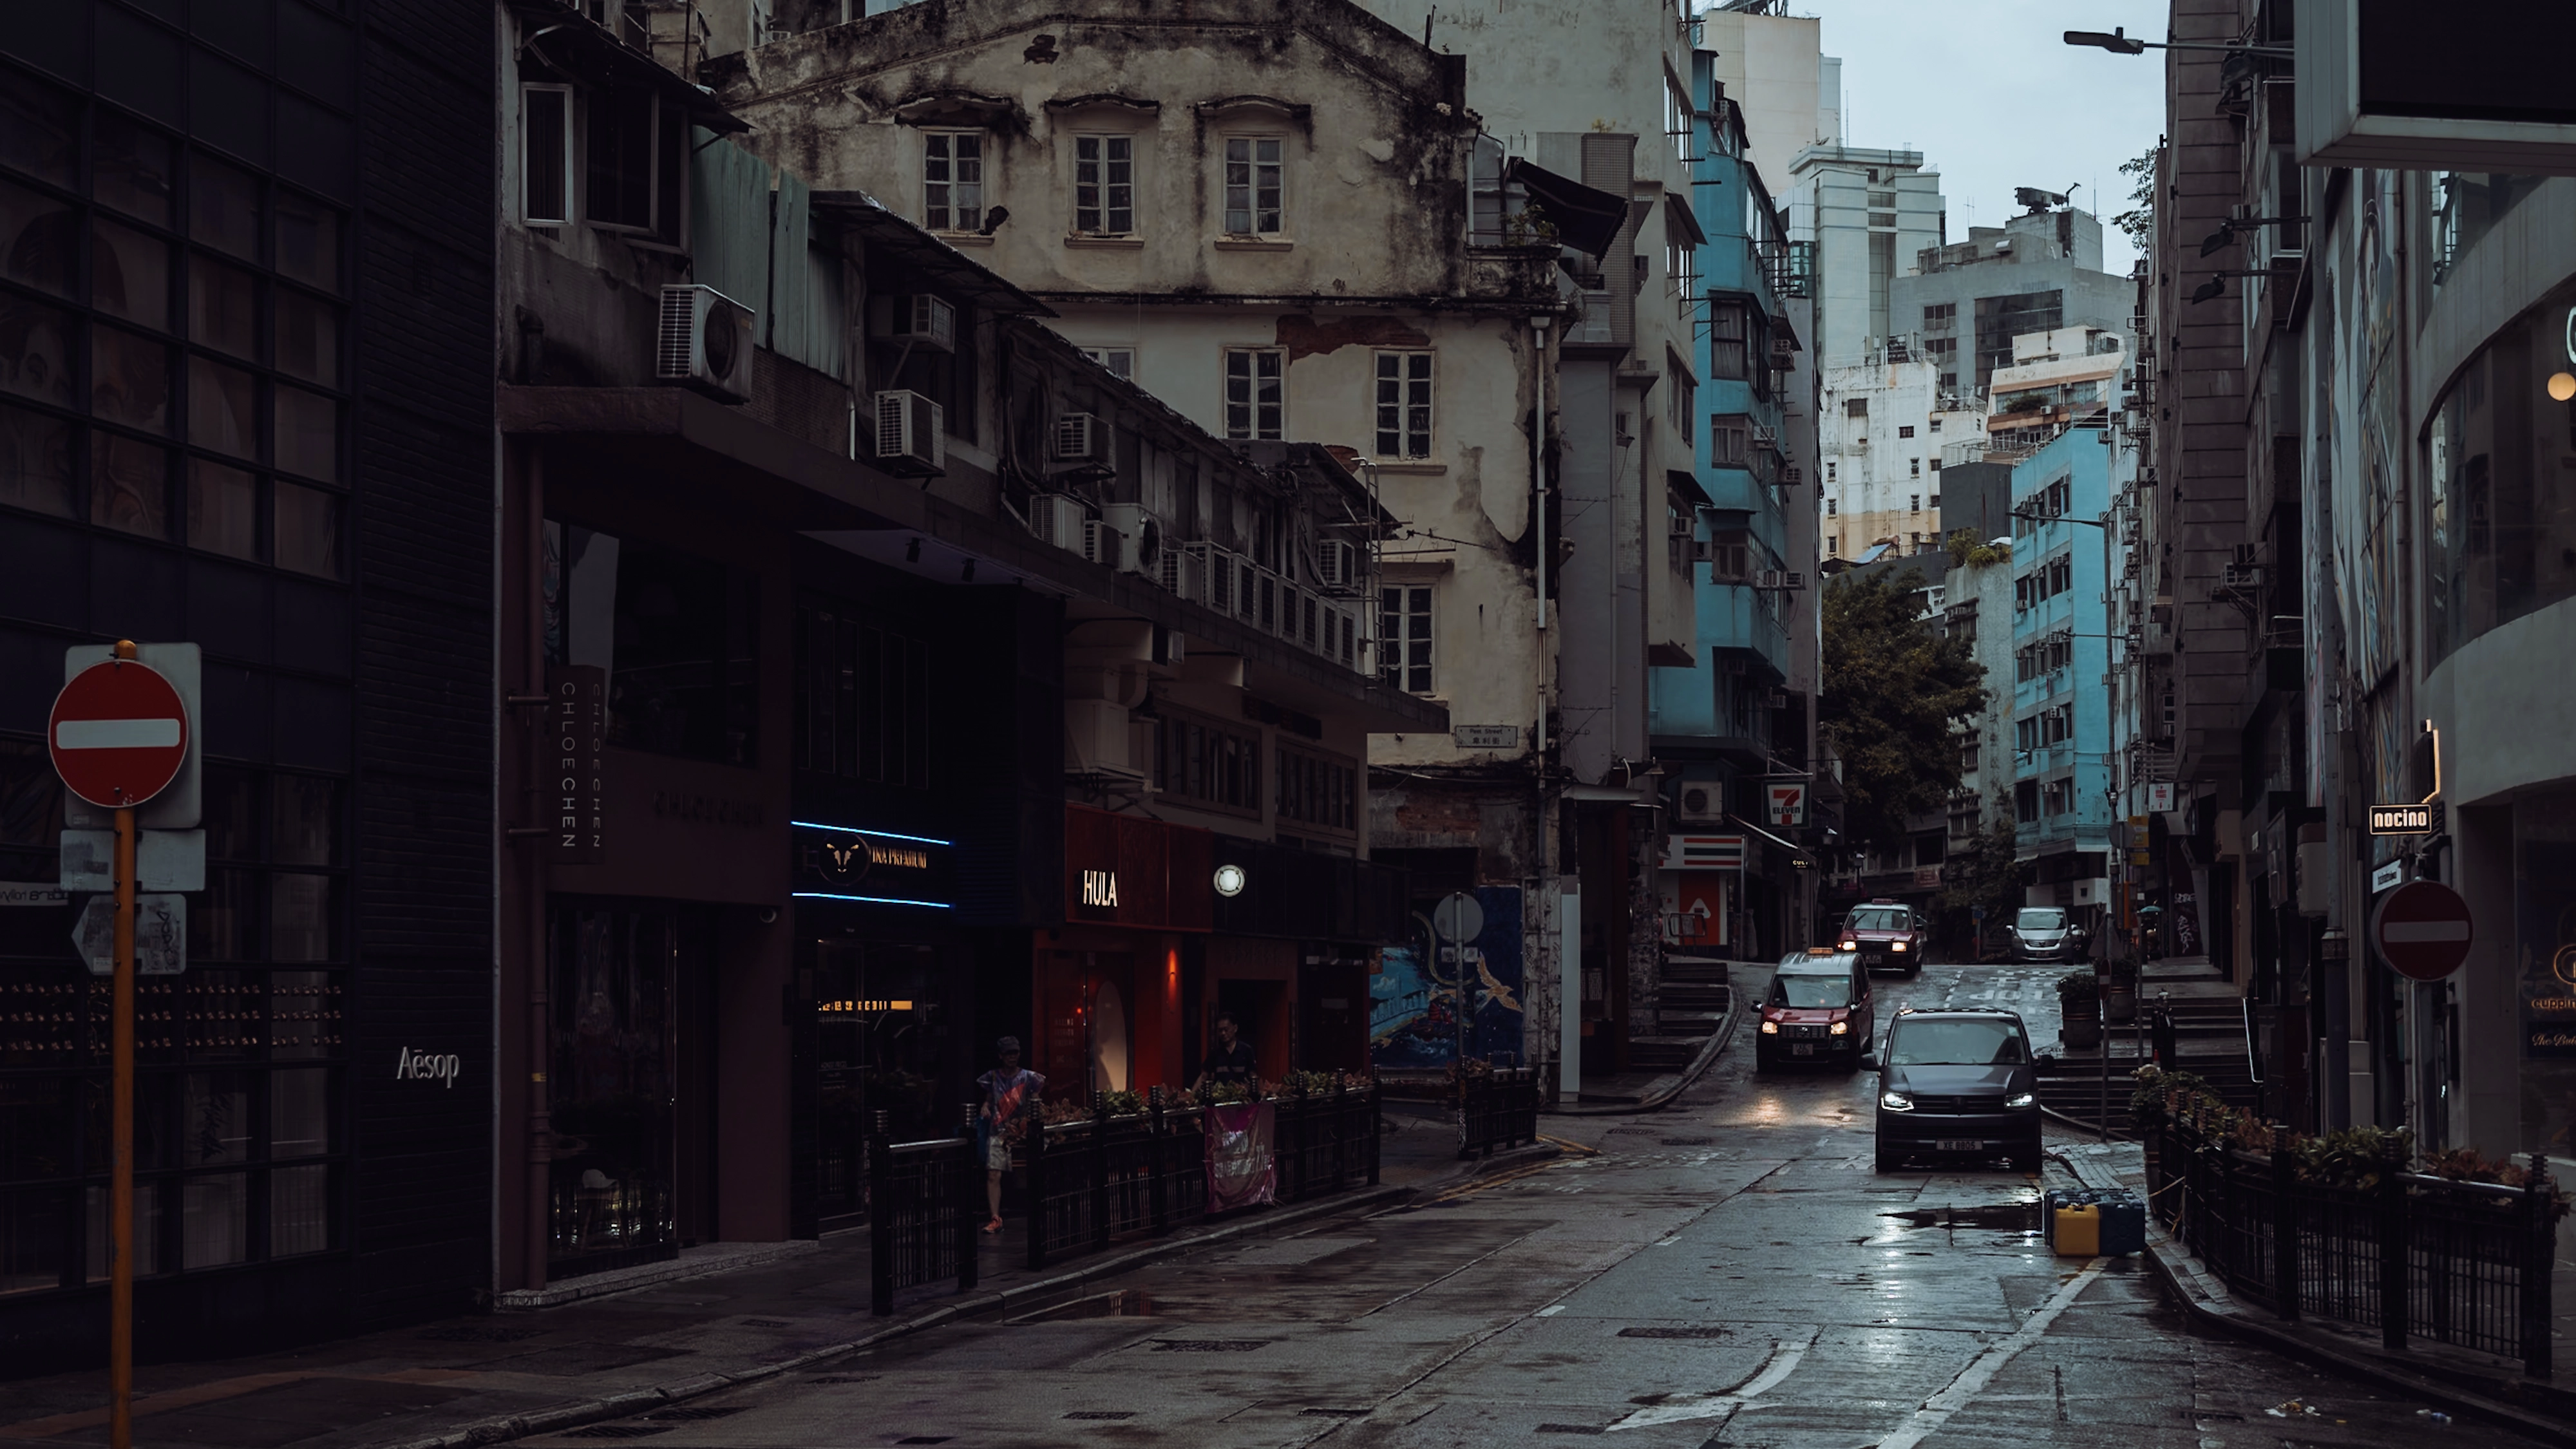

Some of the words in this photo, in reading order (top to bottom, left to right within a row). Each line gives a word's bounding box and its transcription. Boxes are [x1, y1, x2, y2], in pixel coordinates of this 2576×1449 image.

[1773, 789, 1800, 825] 7
[2374, 808, 2427, 828] nocino
[889, 848, 927, 869] PREMIUM
[1082, 869, 1118, 908] HULA
